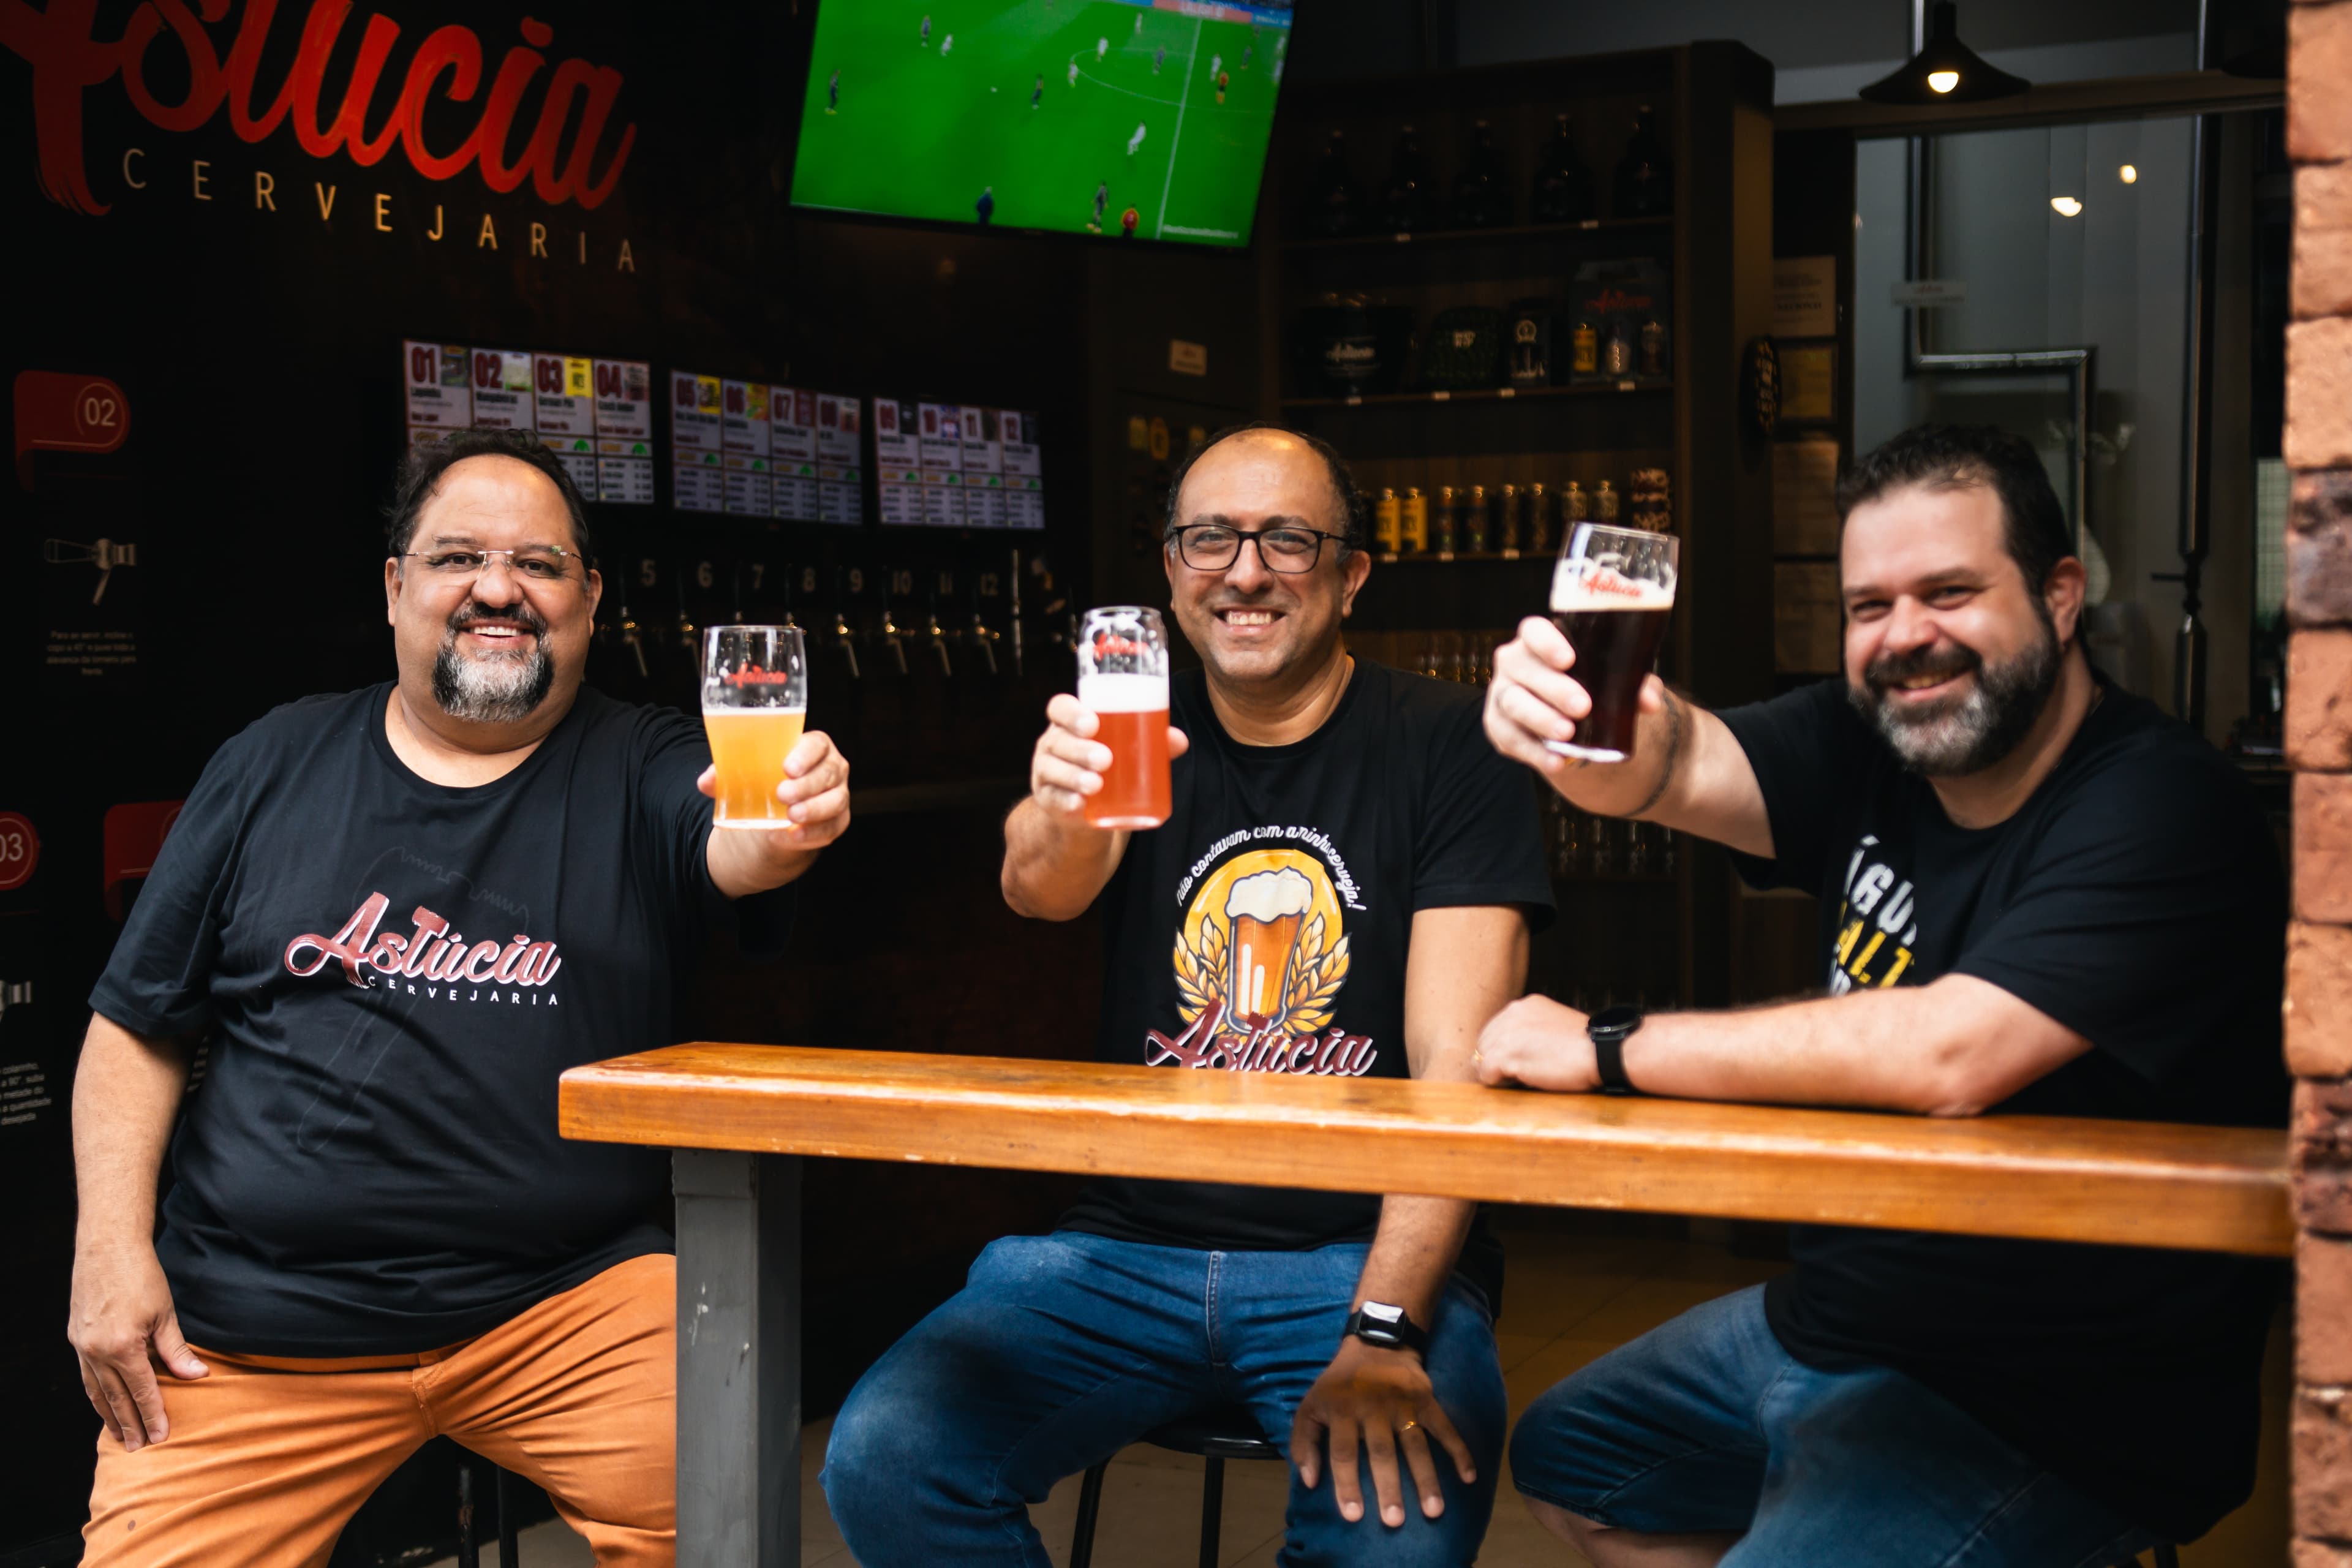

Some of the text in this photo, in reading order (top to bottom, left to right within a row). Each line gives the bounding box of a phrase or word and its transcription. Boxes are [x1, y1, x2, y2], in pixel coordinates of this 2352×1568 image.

[122, 148, 636, 273] CERVEJARIA
[412, 346, 436, 383] 01
[475, 353, 503, 388] 02
[537, 358, 563, 393] 03
[597, 363, 622, 398] 04
[83, 396, 117, 428] 02
[774, 393, 791, 421] 07
[641, 557, 657, 588] 5
[697, 559, 714, 589] 6
[752, 562, 765, 591] 7
[801, 566, 817, 593] 8
[849, 567, 864, 595] 9
[892, 568, 913, 597] 10
[939, 571, 954, 597] 11
[980, 571, 999, 597] 12
[1177, 875, 1194, 907] não
[1191, 829, 1251, 878] contavam
[1253, 825, 1284, 839] com
[284, 891, 562, 990] Astúcia
[368, 974, 559, 1006] CERVEJARIA
